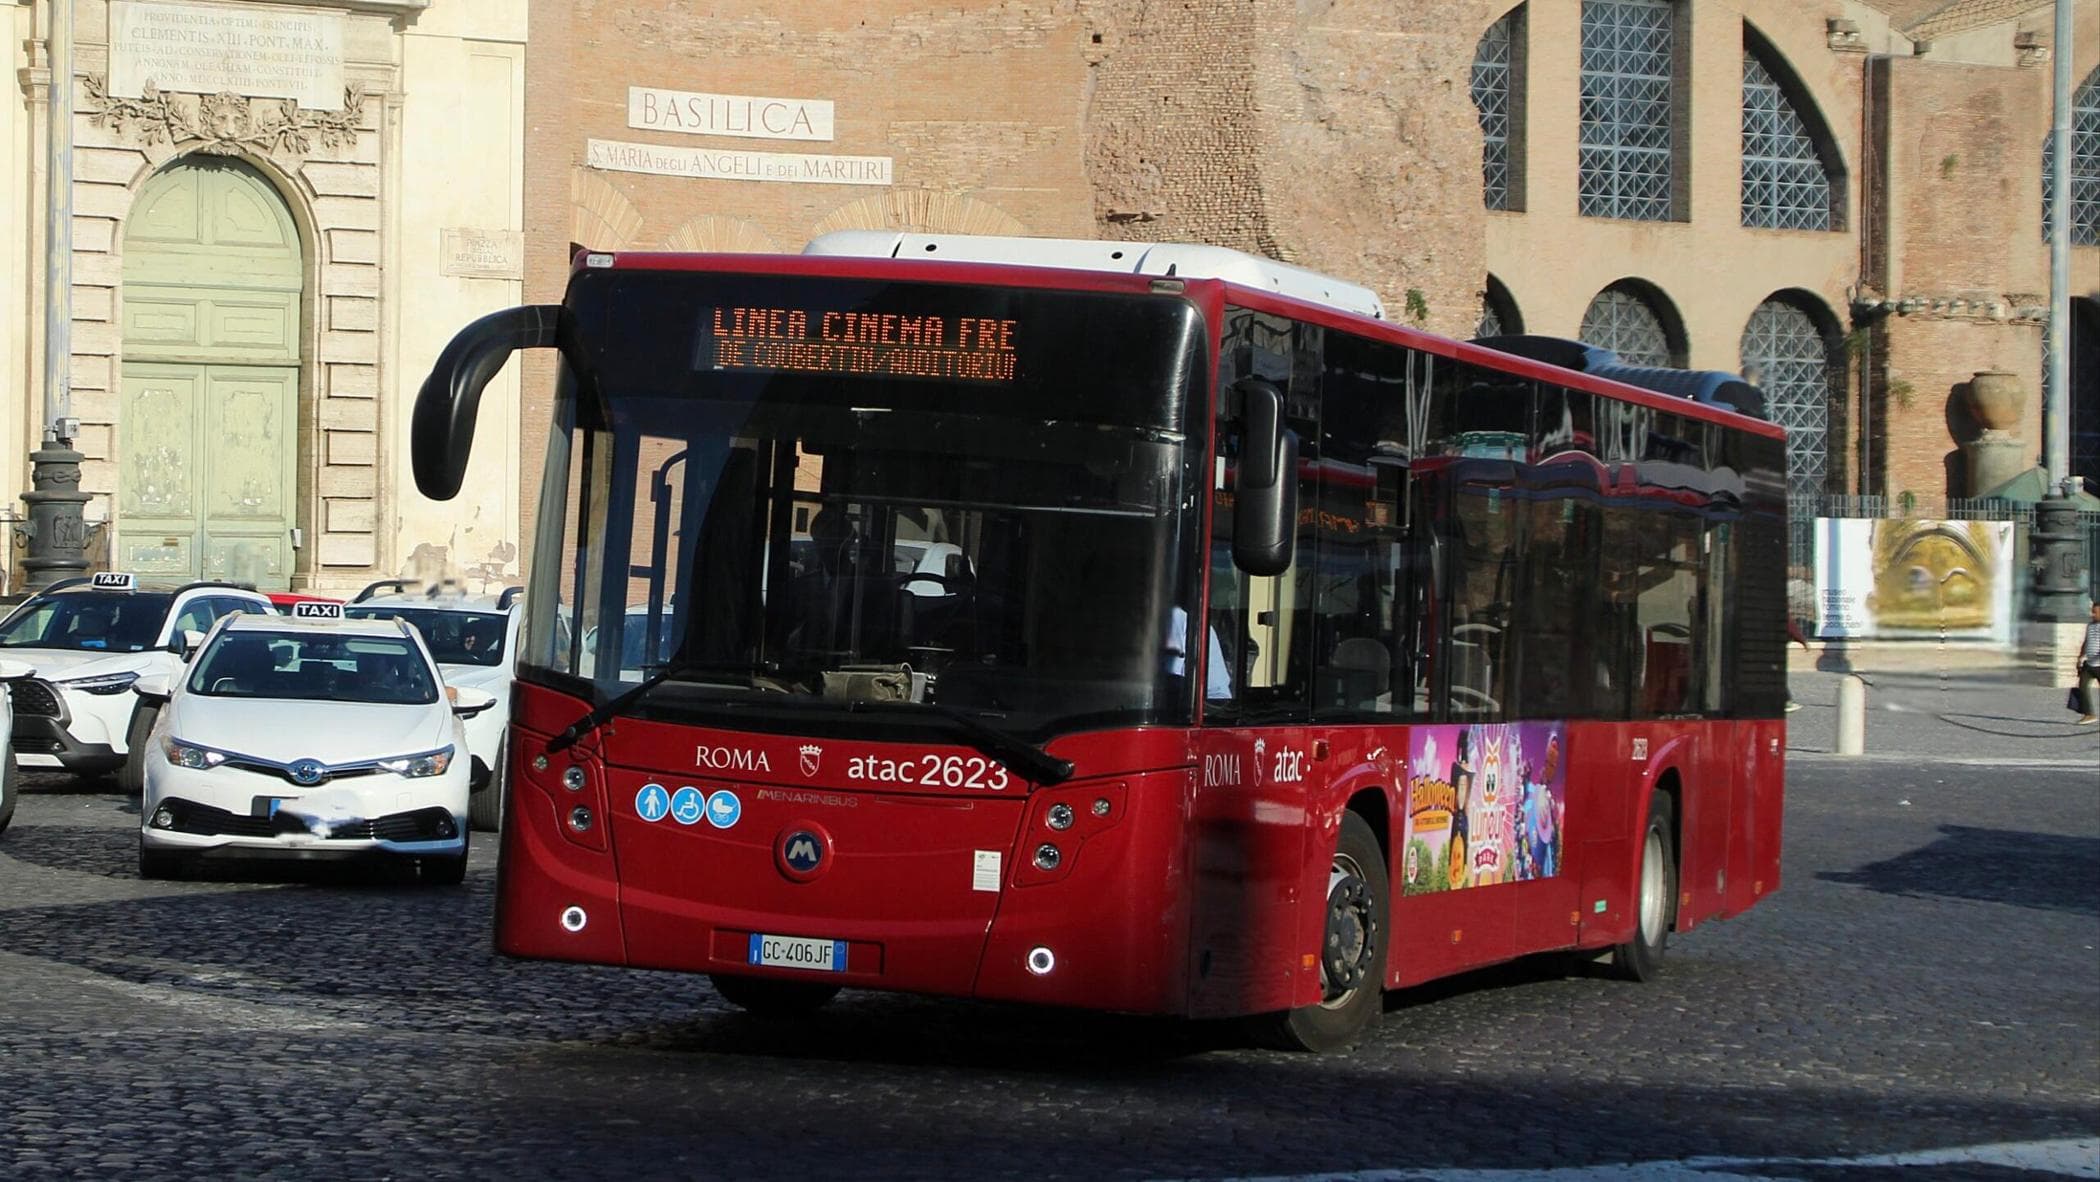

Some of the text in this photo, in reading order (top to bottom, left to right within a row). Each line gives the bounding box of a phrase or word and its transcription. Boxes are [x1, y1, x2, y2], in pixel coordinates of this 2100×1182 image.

[131, 27, 209, 43] CLEMENTIS
[643, 91, 814, 136] BASILICA
[592, 143, 884, 180] S. MARIA DEGLI ANGELI E DEI MARTIRI
[713, 307, 1017, 350] LINEA CINEMA FRE
[719, 339, 747, 367] DE
[98, 574, 126, 585] TAXI
[299, 605, 338, 617] TAXI
[696, 746, 771, 772] ROMA
[848, 754, 1009, 790] atac 2623
[1204, 754, 1241, 787] ROMA
[1274, 745, 1304, 783] atac
